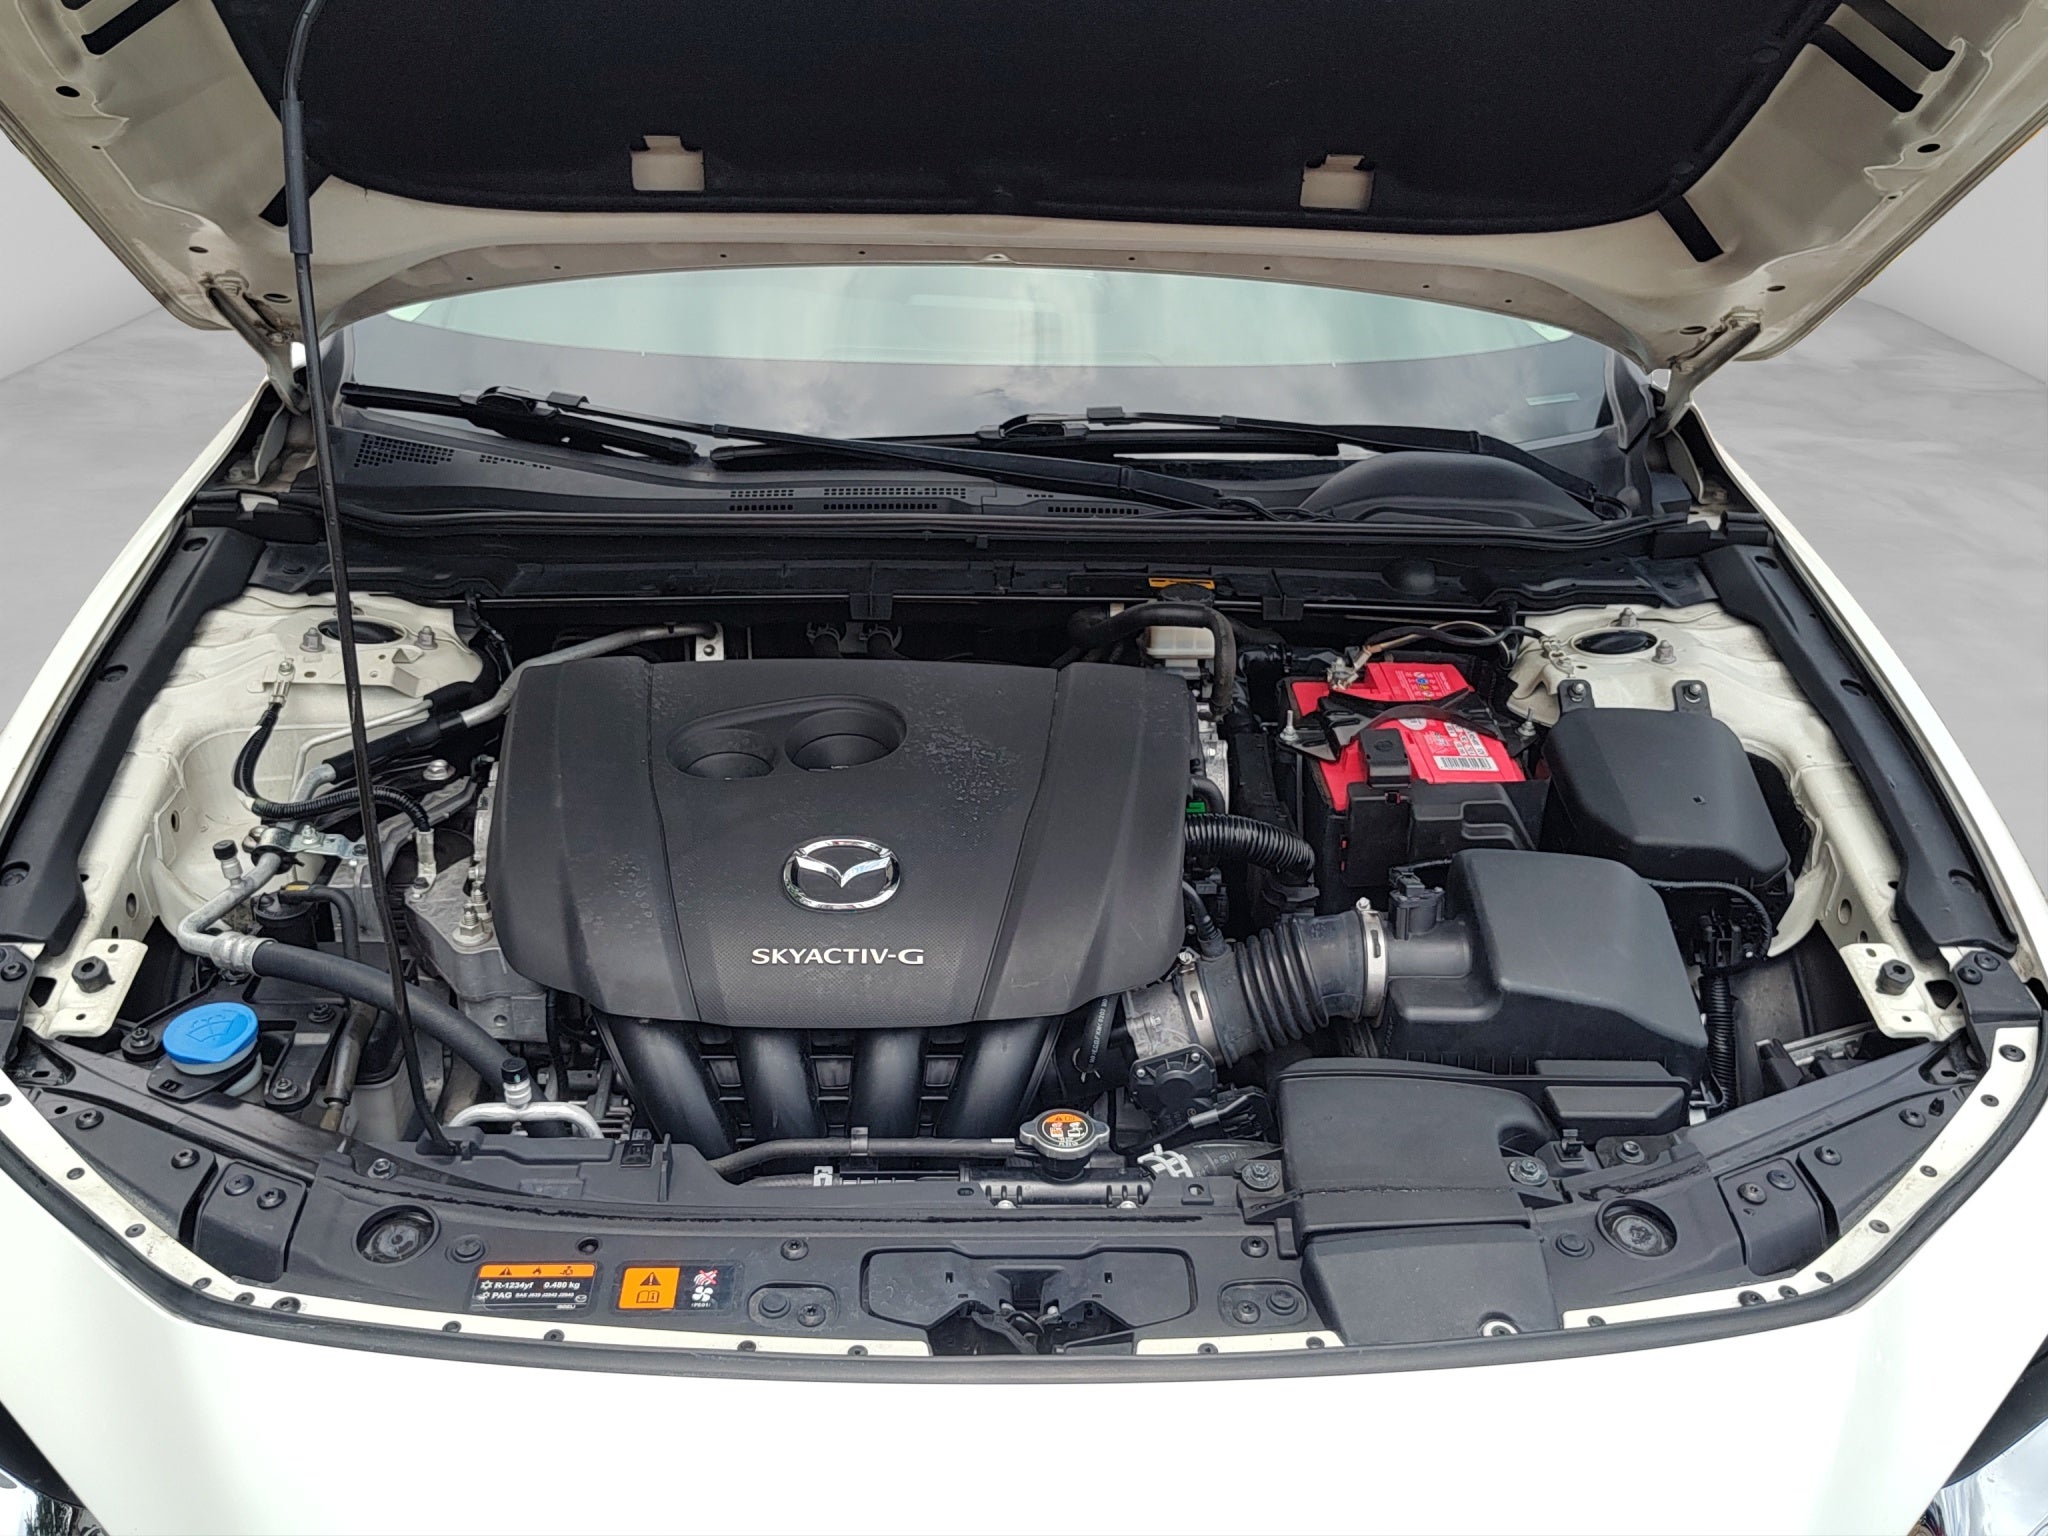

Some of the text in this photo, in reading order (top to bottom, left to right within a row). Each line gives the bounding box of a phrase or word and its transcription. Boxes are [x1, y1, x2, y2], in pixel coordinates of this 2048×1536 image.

[751, 947, 925, 965] SKYACTIV-G
[493, 1281, 535, 1290] R-1234yf
[568, 1281, 581, 1291] kg
[490, 1291, 513, 1300] PAG
